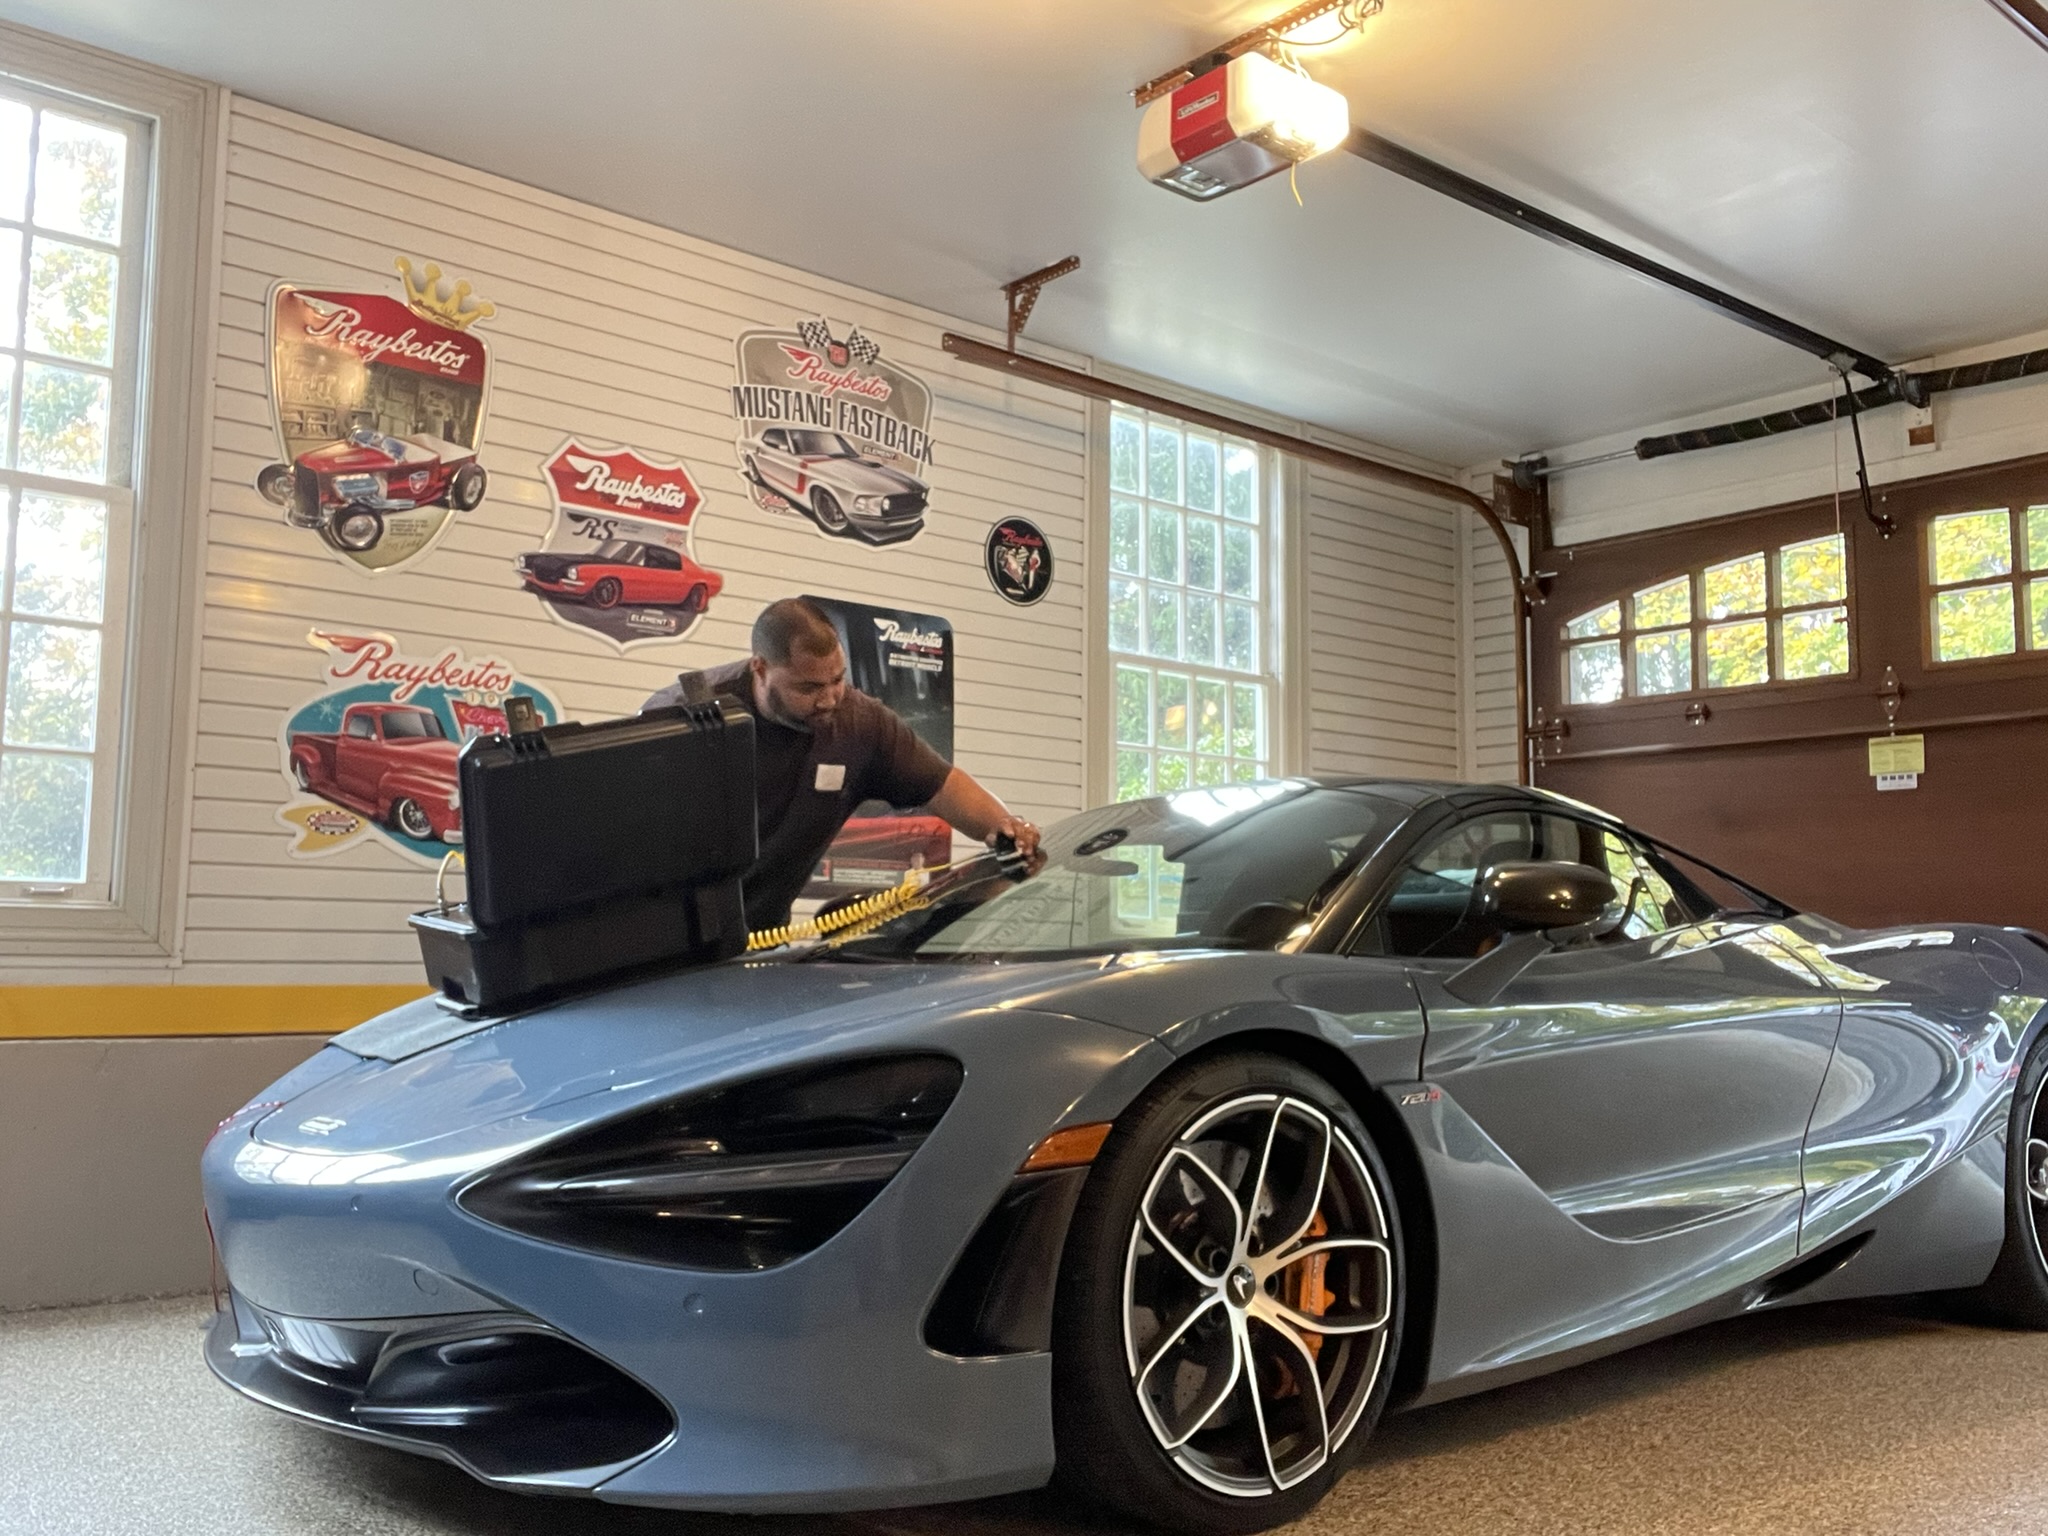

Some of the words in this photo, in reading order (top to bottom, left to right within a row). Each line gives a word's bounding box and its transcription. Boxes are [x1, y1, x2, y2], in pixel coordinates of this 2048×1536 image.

[292, 292, 471, 370] Raybestos
[777, 342, 892, 402] Raybestos
[732, 386, 833, 428] MUSTANG
[839, 402, 936, 466] FASTBACK
[566, 454, 687, 508] Raybestos
[567, 512, 619, 541] RS
[873, 617, 944, 650] Raybestos
[311, 630, 513, 702] Raybestos
